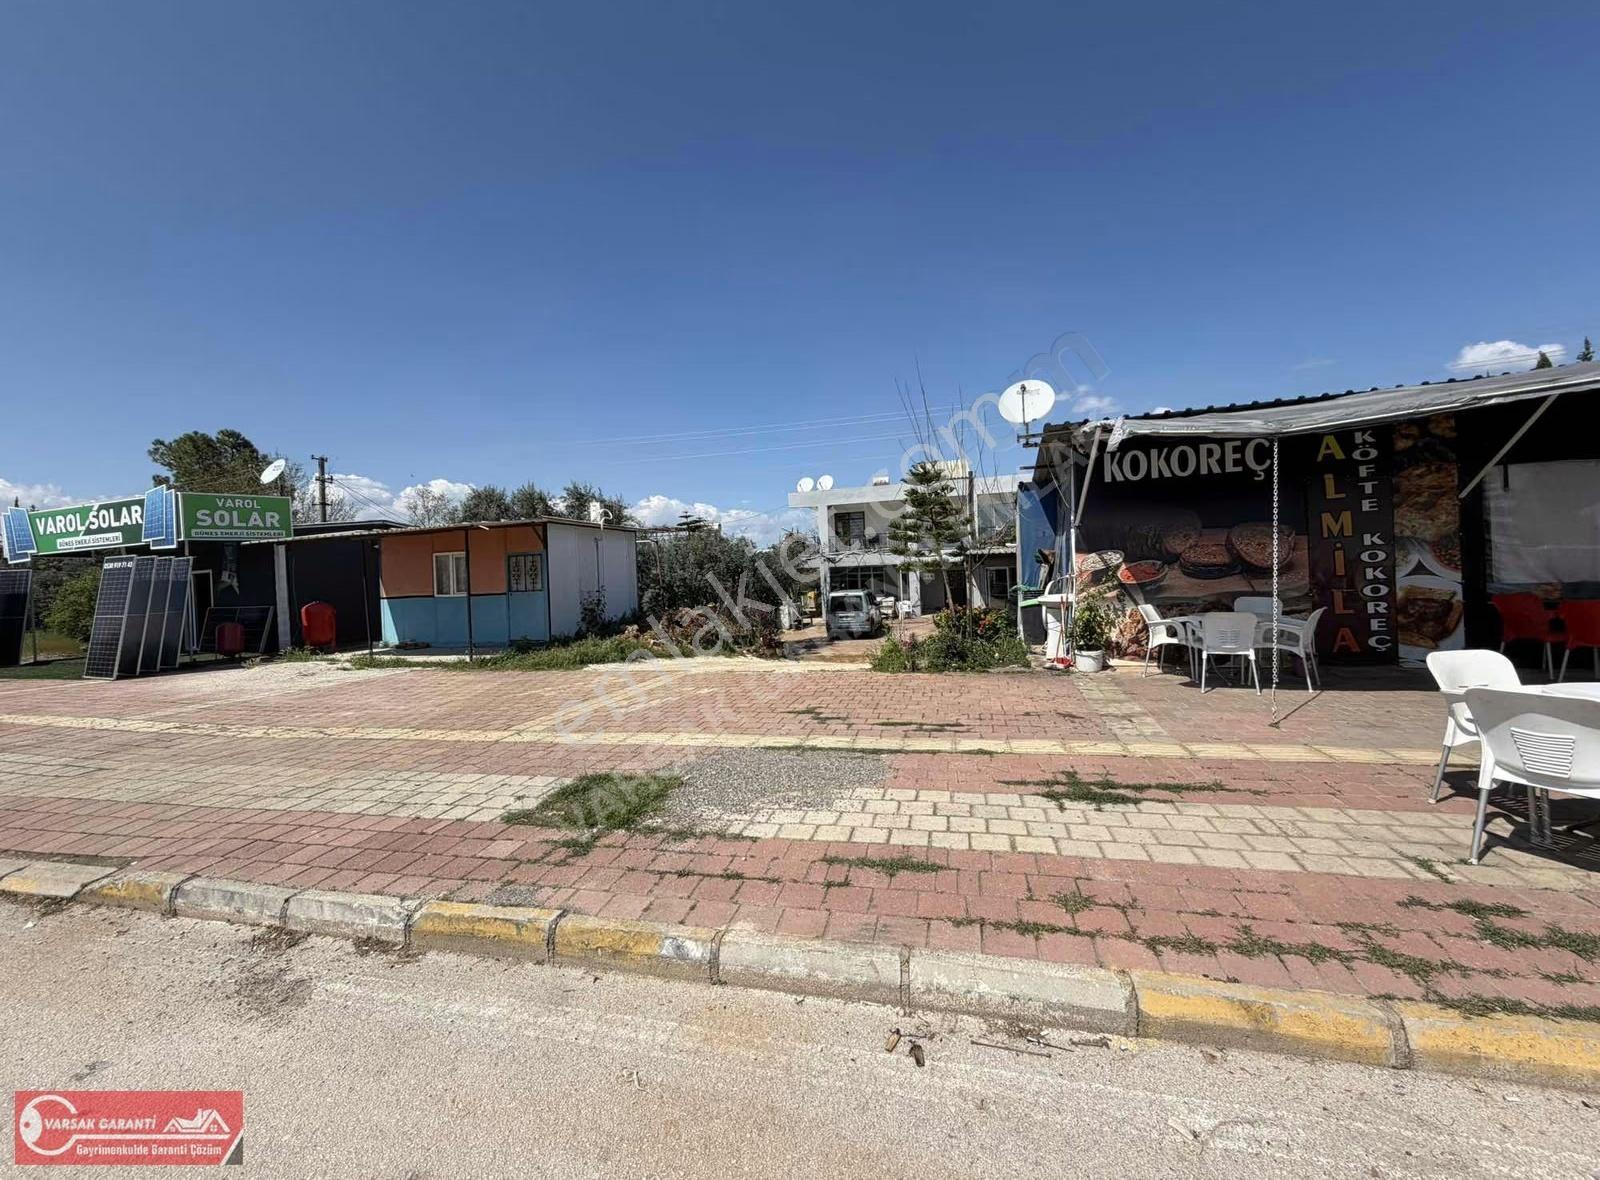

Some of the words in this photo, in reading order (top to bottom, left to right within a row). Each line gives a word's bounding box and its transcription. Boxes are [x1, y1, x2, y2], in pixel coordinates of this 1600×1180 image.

[1104, 438, 1272, 483] KOKOREÇ
[1352, 430, 1379, 512] KÖFTE
[36, 513, 85, 536] VAROL
[88, 505, 143, 530] SOLAR
[196, 509, 280, 528] SOLAR
[216, 498, 261, 509] VAROL
[1316, 434, 1361, 653] ALMİLA
[1360, 532, 1392, 652] KOKOREÇ
